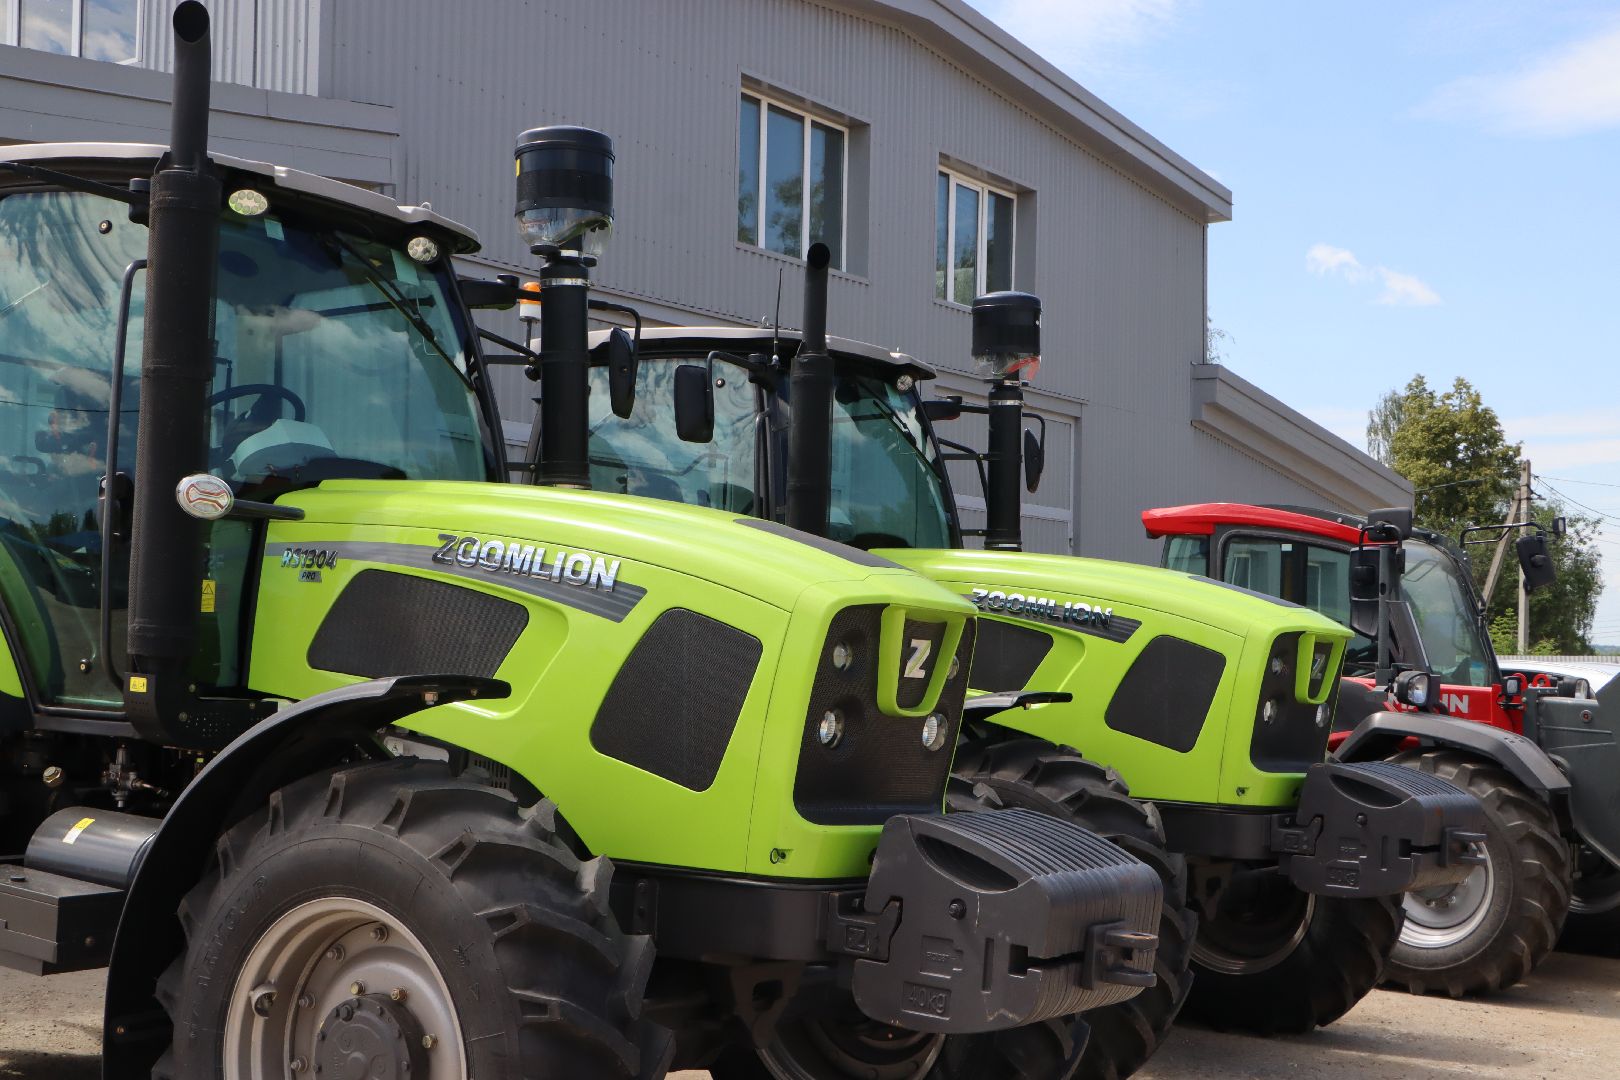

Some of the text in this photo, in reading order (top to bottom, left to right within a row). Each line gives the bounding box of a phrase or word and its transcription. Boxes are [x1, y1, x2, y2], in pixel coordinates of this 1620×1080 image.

[281, 547, 338, 570] RS1304
[432, 534, 621, 592] ZOOMLION
[301, 571, 317, 581] PRO
[972, 588, 1112, 629] ZOOMLION
[904, 639, 931, 678] Z
[906, 984, 947, 1014] 40kg
